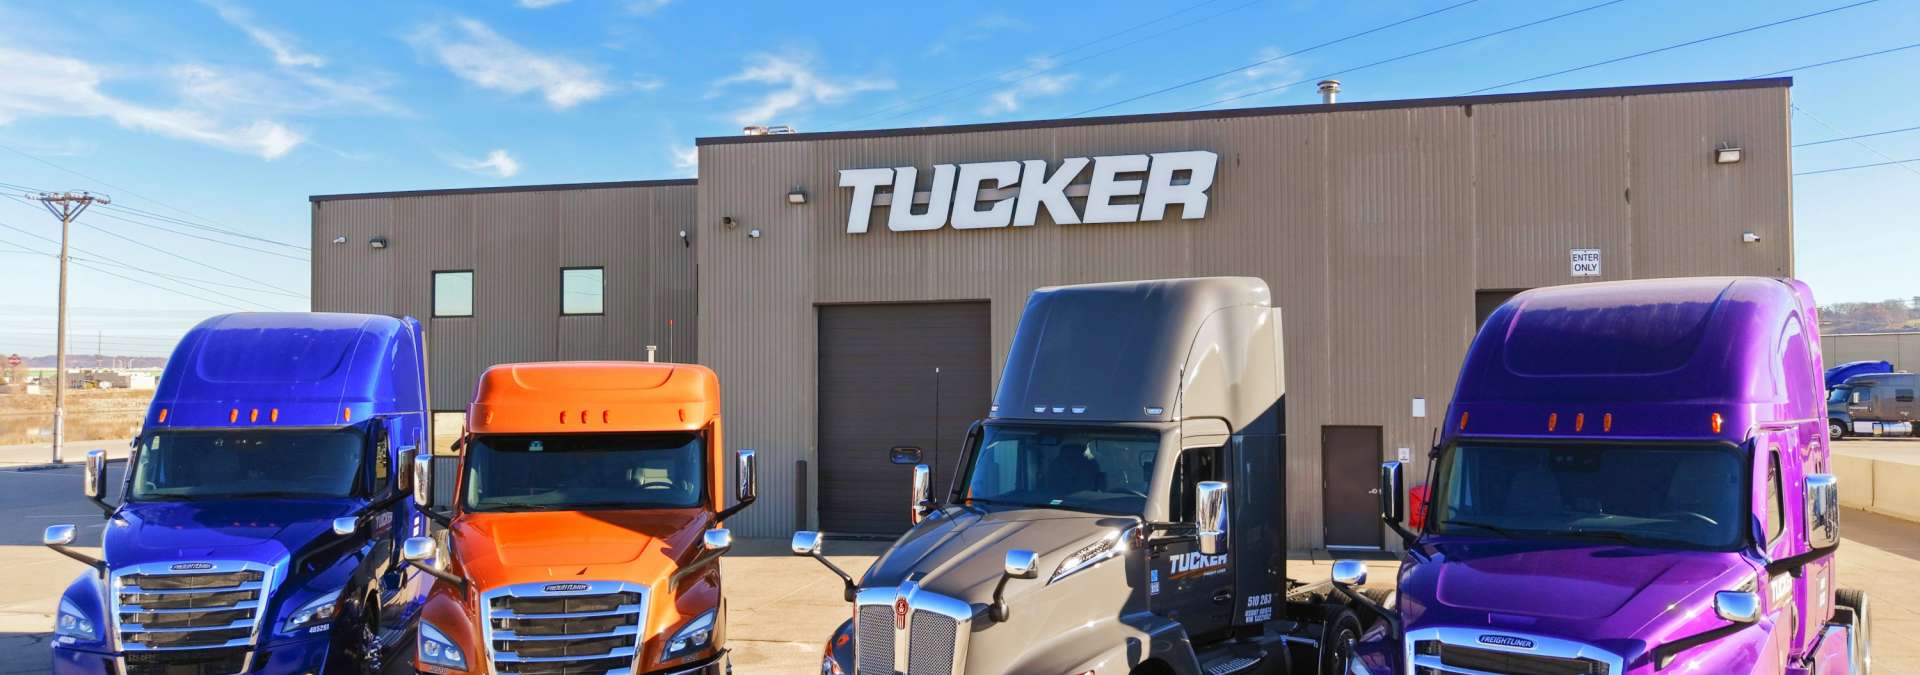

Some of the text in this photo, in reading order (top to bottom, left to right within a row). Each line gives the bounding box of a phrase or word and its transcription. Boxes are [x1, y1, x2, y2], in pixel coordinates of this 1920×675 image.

[838, 150, 1218, 234] TUCKER
[1572, 254, 1599, 262] ENTER
[1574, 263, 1597, 272] ONLY
[1481, 635, 1532, 648] FREIGHTLINER
